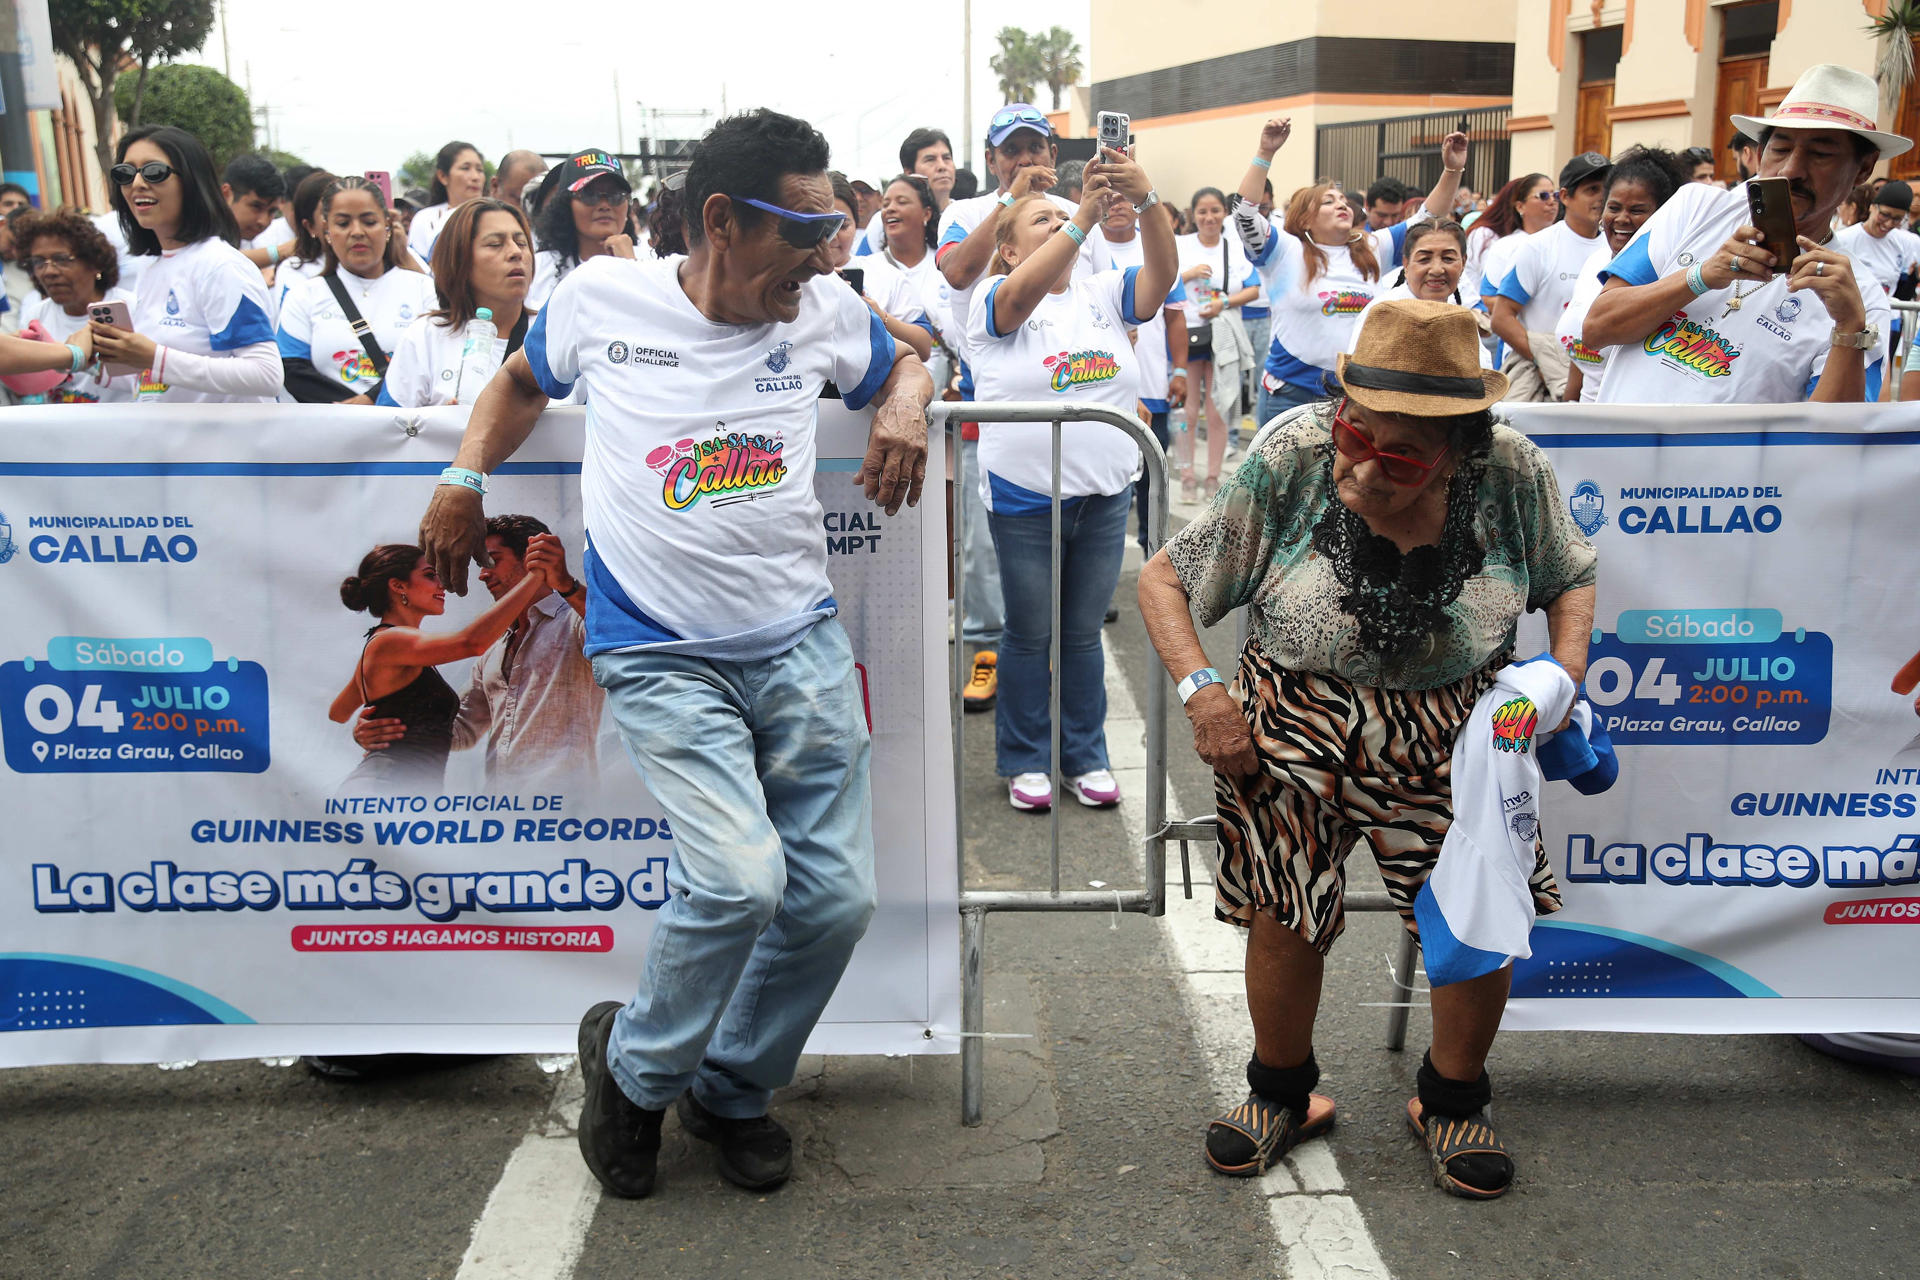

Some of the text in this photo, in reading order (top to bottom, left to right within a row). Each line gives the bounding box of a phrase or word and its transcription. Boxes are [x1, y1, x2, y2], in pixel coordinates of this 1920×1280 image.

[574, 153, 620, 169] TRUJILLO
[1756, 317, 1791, 341] CALLAO
[636, 347, 680, 360] OFFICIAL
[1644, 321, 1731, 378] Callao
[634, 357, 680, 368] CHALLENGE
[1051, 357, 1122, 392] Callao
[755, 380, 803, 393] CALLAO
[662, 447, 788, 511] Callao
[1620, 486, 1782, 500] MUNICIPALIDAD DEL
[28, 516, 194, 529] MUNICIPALIDAD DEL
[823, 512, 882, 532] CIAL
[1617, 504, 1782, 535] CALLAO
[28, 534, 198, 564] CALLAO
[1644, 613, 1755, 639] Sábado
[75, 642, 185, 668] Sábado
[1585, 656, 1682, 706] 04
[1692, 656, 1796, 682] JULIO
[24, 683, 125, 735] 04
[131, 685, 230, 711] JULIO
[1688, 685, 1809, 709] 2:00 p.m.
[131, 712, 246, 737] 2:00 p.m.
[1492, 696, 1538, 739] llao
[1606, 715, 1801, 733] Plaza Grau, Callao
[54, 743, 244, 761] Plaza Grau, Callao
[325, 795, 563, 815] INTENTO OFICIAL DE
[1503, 790, 1530, 808] CALL
[1730, 792, 1916, 818] GUINNESS
[190, 817, 674, 846] GUINNESS WORLD RECORDS
[1566, 833, 1920, 888] La clase má
[31, 857, 679, 923] La clase más grande d
[1834, 902, 1920, 919] JUNTOS
[302, 928, 602, 948] JUNTOS HAGAMOS HISTORIA
